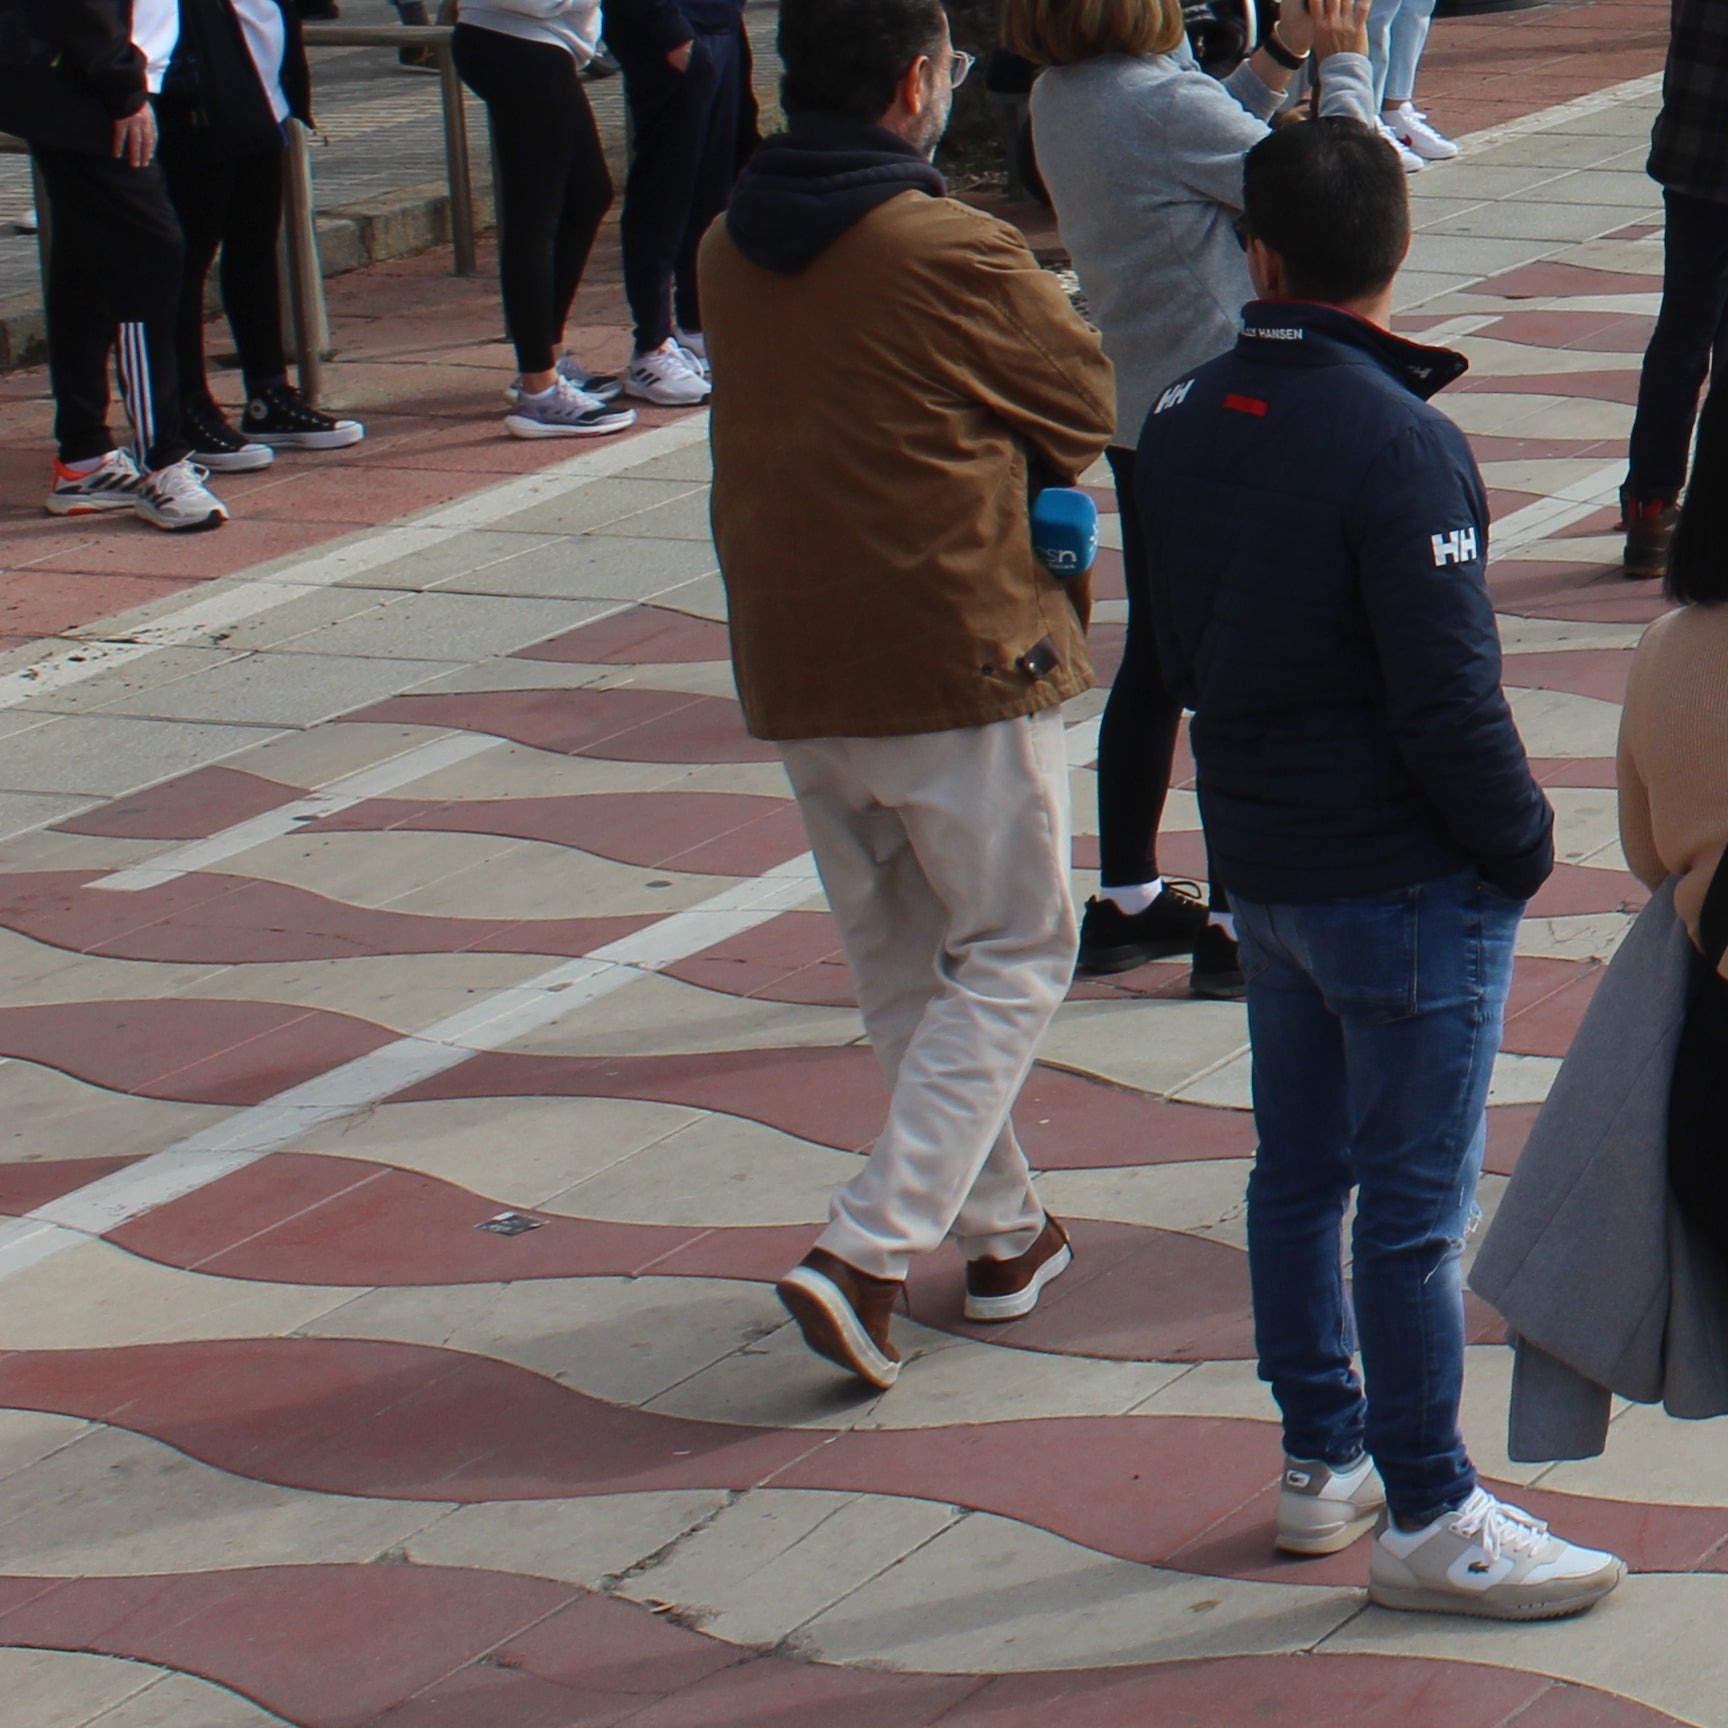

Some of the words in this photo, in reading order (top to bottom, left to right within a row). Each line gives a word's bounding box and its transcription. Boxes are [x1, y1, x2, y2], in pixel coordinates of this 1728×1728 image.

[1258, 328, 1303, 340] HANSEN
[1154, 379, 1195, 414] HH
[1431, 527, 1478, 567] HH
